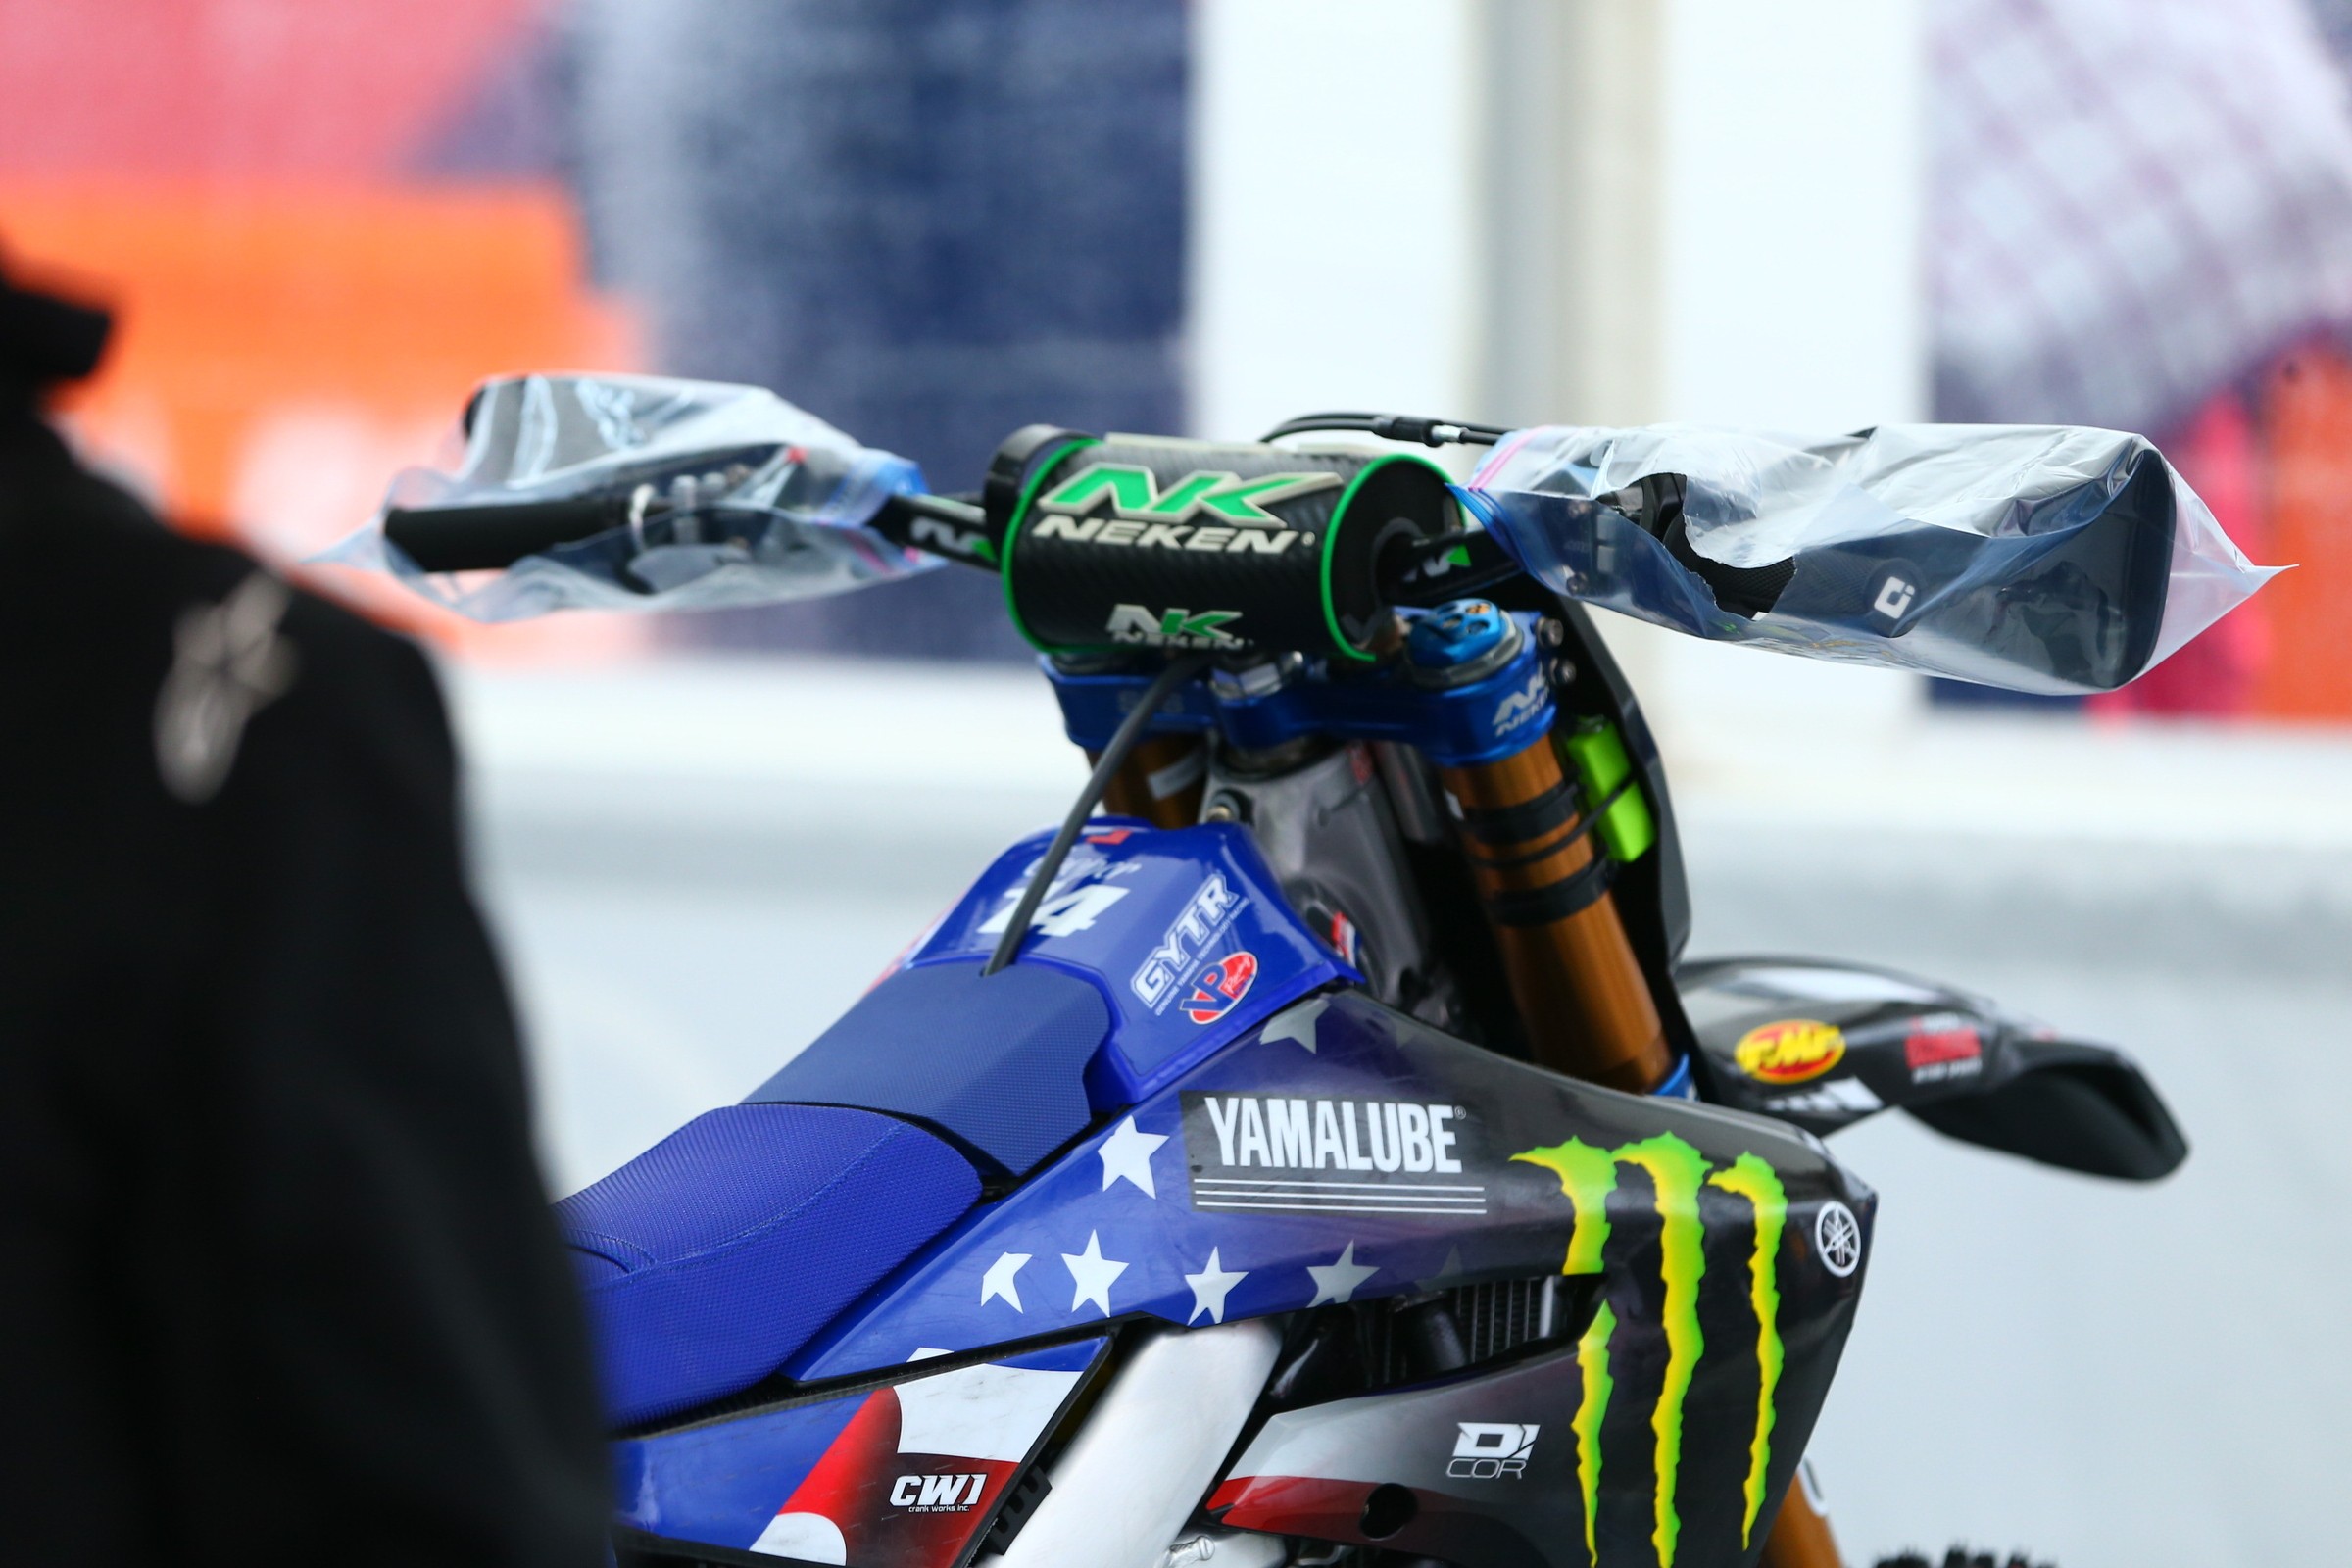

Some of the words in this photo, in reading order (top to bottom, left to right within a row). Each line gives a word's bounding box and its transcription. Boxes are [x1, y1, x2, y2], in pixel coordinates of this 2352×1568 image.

[1037, 462, 1344, 530] NK
[1032, 514, 1300, 554] NEKEN
[1106, 603, 1243, 640] NK
[1130, 871, 1239, 1009] GYTR
[1180, 962, 1236, 1013] VP
[1204, 1097, 1463, 1174] YAMALUBE
[1446, 1457, 1528, 1480] COR
[908, 1504, 930, 1513] crank
[931, 1504, 956, 1513] works
